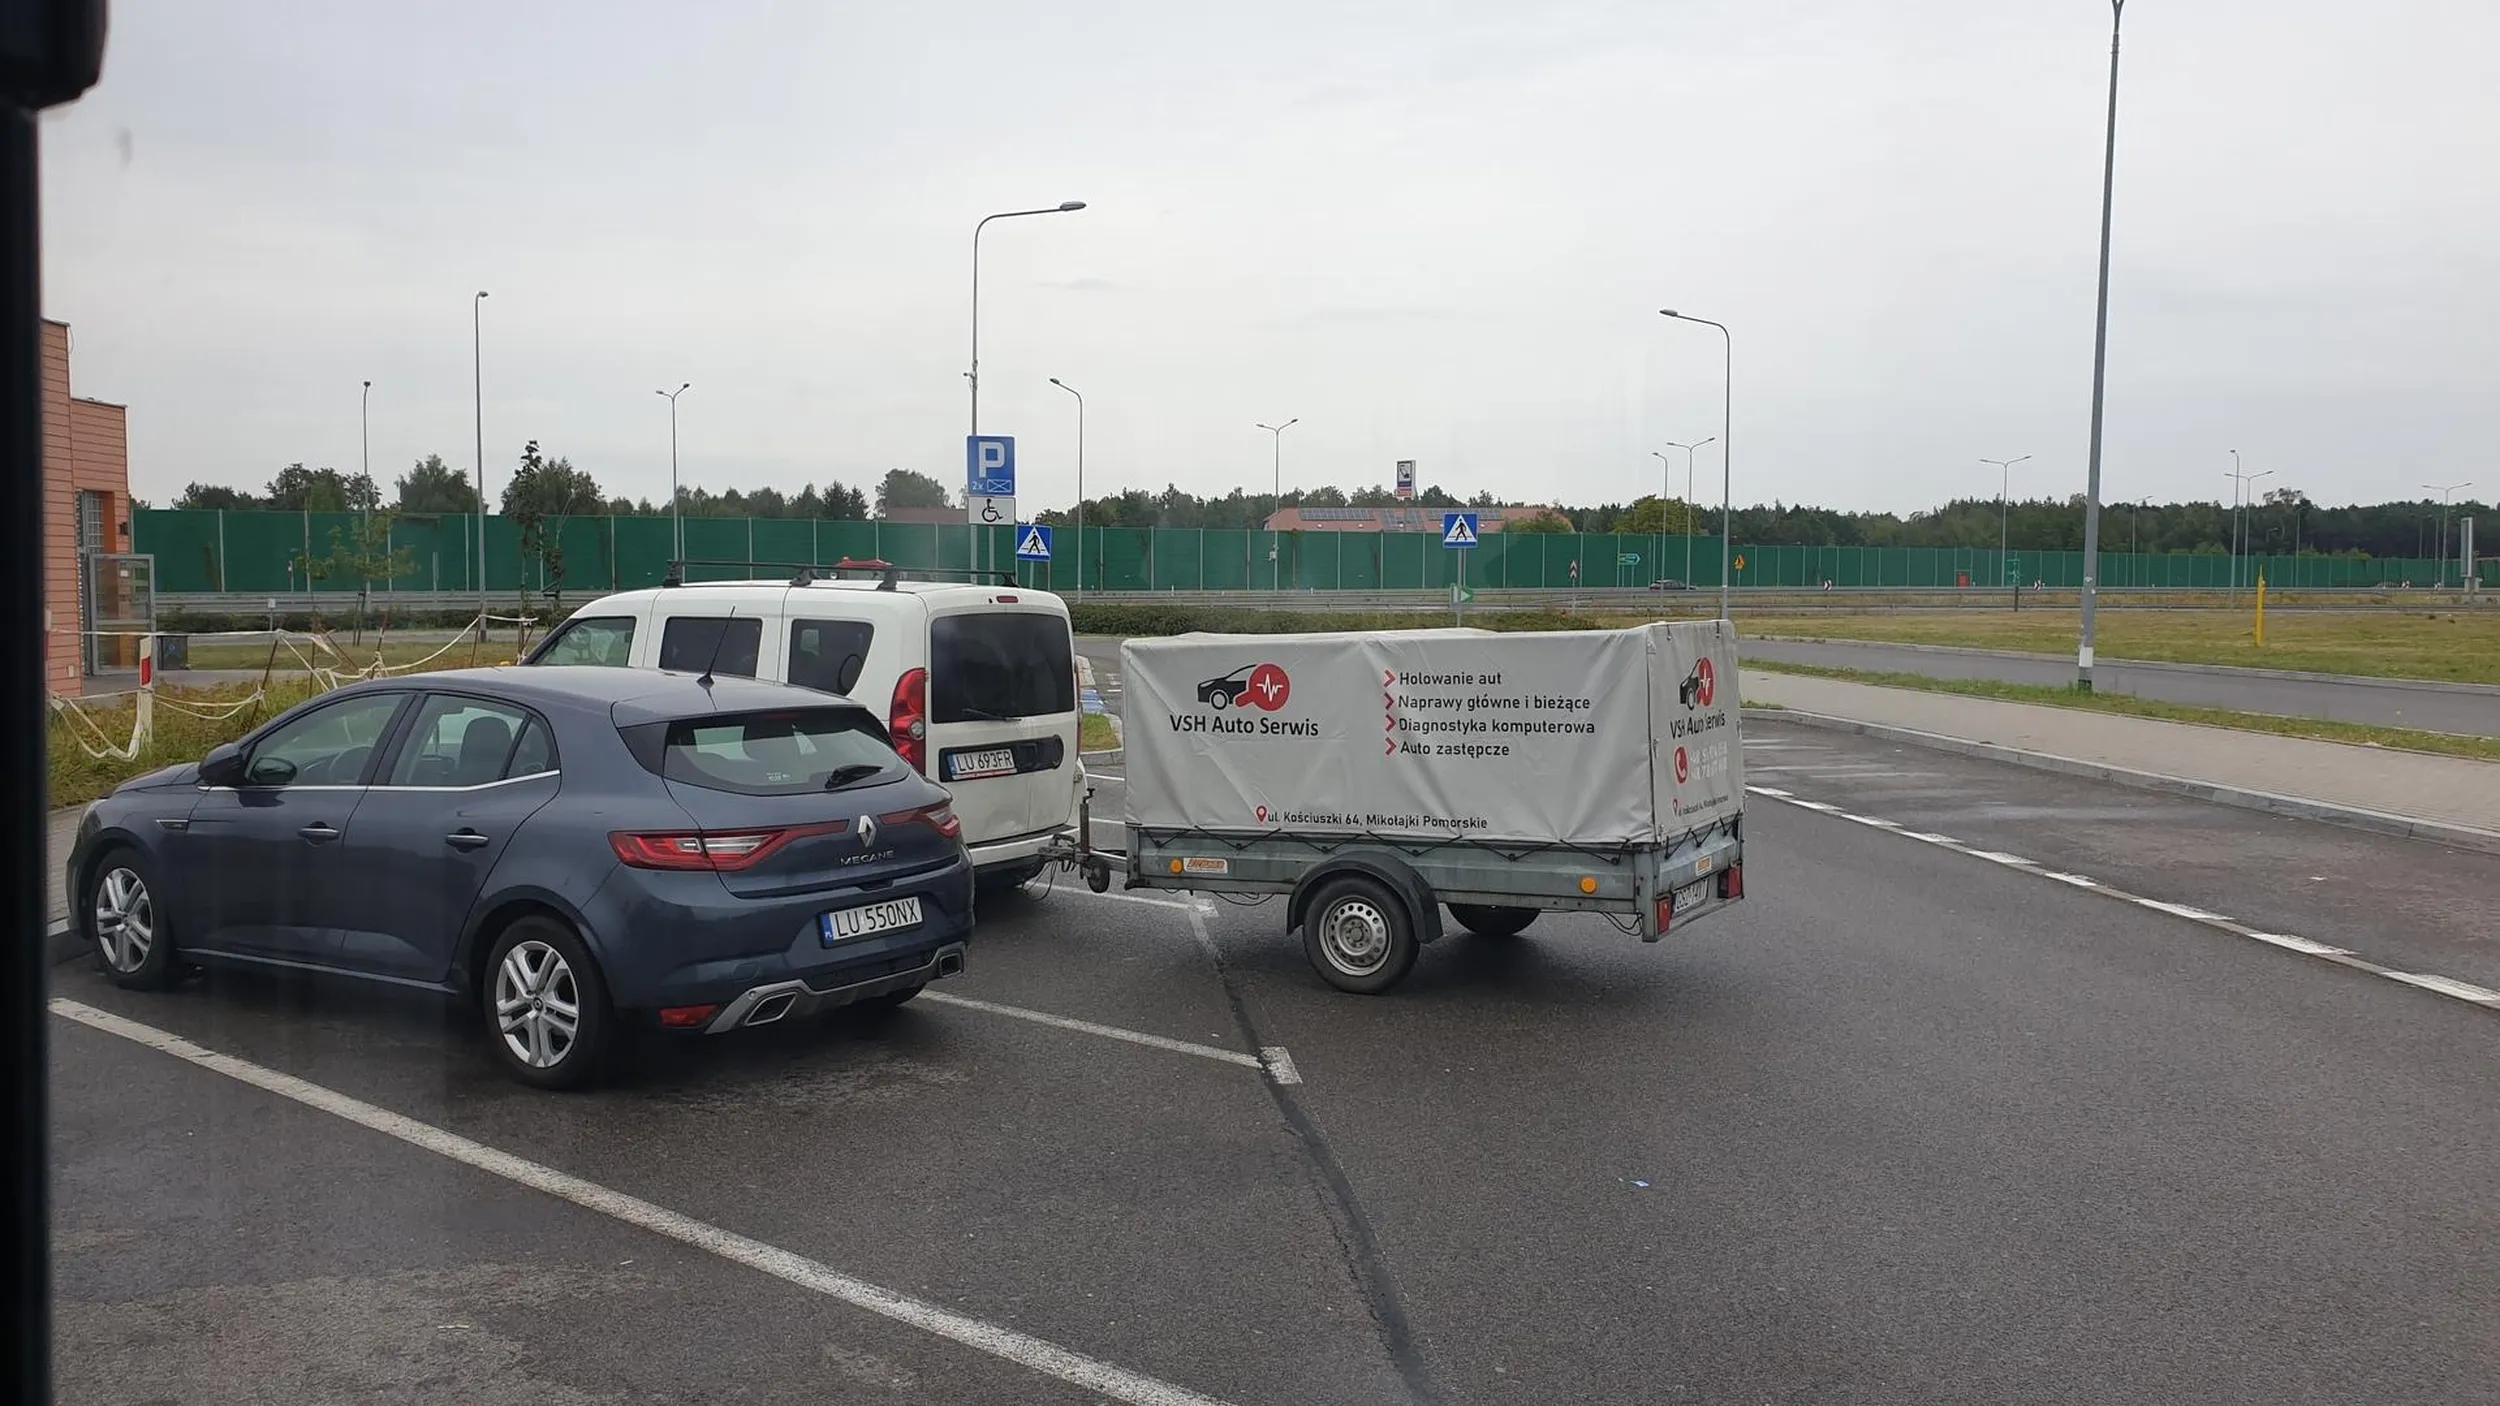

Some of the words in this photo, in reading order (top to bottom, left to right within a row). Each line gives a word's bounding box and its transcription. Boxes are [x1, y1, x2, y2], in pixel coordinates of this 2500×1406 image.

[979, 441, 1005, 478] P
[1400, 672, 1474, 685] Holowanie
[1478, 672, 1502, 685] aut
[1398, 694, 1462, 711] Naprawy
[1467, 693, 1520, 711] główne
[1525, 695, 1529, 709] i
[1534, 695, 1590, 713] bieżące
[1170, 714, 1206, 732] VSH
[1212, 716, 1254, 733] Auto
[1260, 717, 1319, 736] Serwis
[1399, 718, 1487, 734] Diagnostyka
[1492, 719, 1595, 735] komputerowa
[1400, 741, 1430, 755] Auto
[1436, 743, 1510, 758] zastępcze
[956, 754, 975, 771] LU
[978, 751, 1013, 769] 693FR
[1284, 812, 1342, 825] Kościuszki
[1345, 814, 1363, 827] 64,
[1366, 814, 1419, 828] Mikołajki
[1423, 815, 1488, 829] Pomorskie
[840, 850, 894, 865] MEGANE
[834, 910, 860, 937] LU
[865, 899, 919, 930] 550NX
